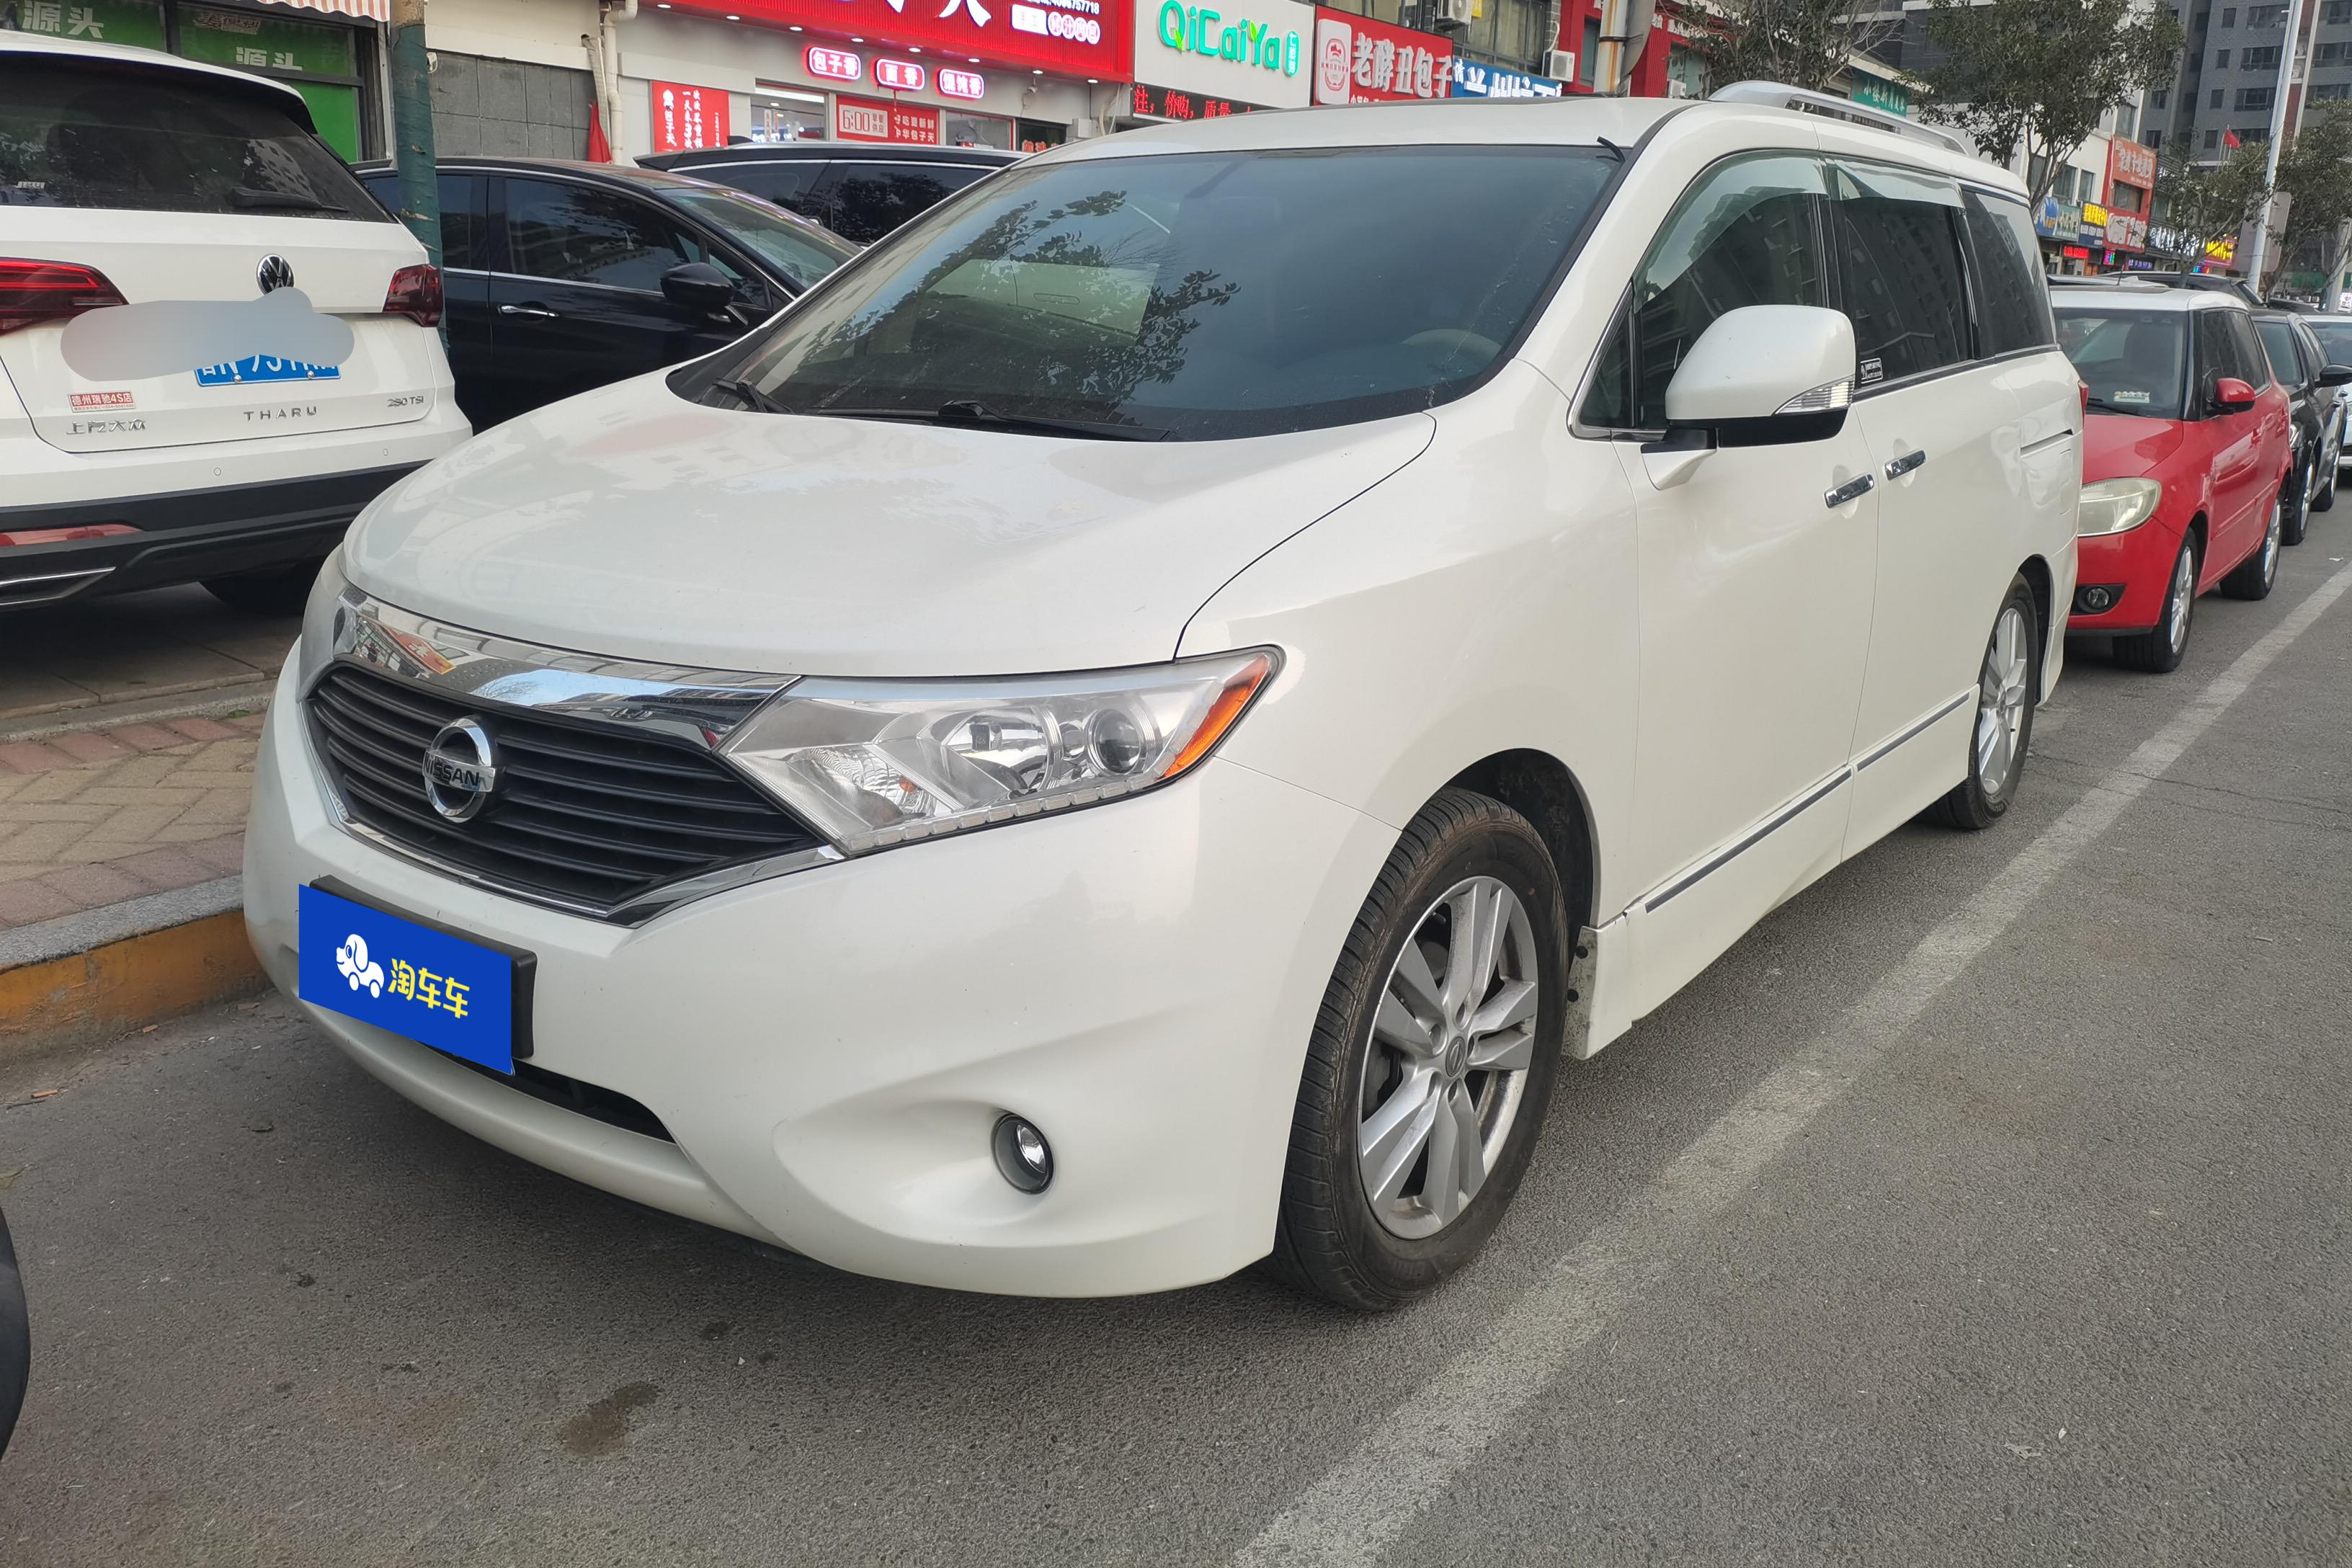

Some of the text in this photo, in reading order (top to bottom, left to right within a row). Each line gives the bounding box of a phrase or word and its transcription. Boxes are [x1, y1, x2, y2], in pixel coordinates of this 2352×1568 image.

[22, 0, 104, 39] 源头
[1159, 0, 1280, 70] QiCaiYa
[813, 50, 858, 76] 包子香
[885, 63, 918, 86] 面香
[843, 110, 870, 132] 6:00
[71, 392, 133, 406] 德州瑞驰4S店
[409, 395, 424, 406] TSI
[243, 406, 317, 422] THARU
[66, 418, 146, 435] 上汽大众
[424, 752, 480, 787] NISSAN
